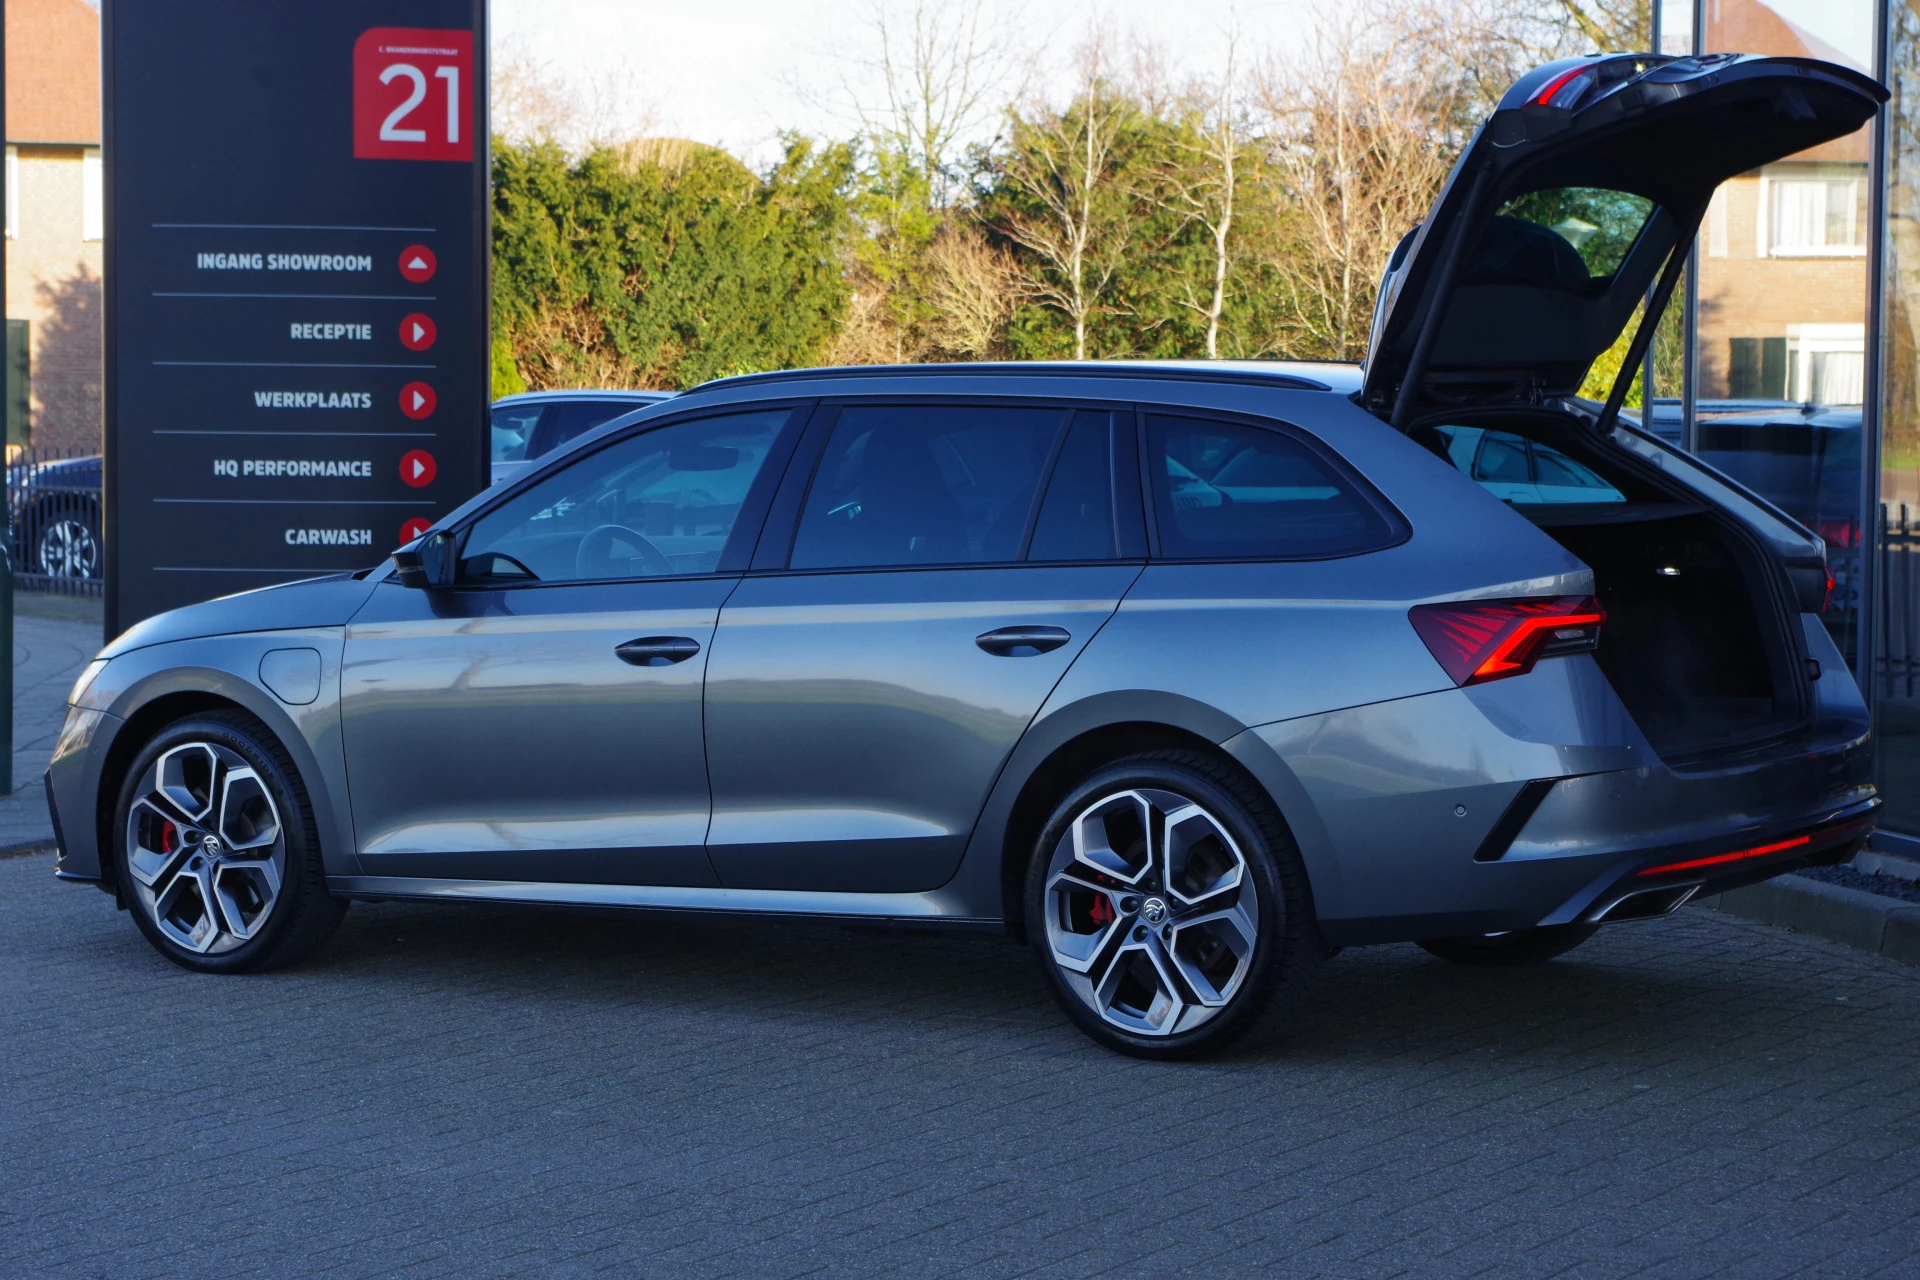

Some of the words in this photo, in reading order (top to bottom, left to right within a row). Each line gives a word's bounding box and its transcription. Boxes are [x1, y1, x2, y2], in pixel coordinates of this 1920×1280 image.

[379, 63, 459, 143] 21
[197, 253, 263, 269] INGANG
[267, 254, 371, 271] SHOWROOM
[291, 323, 371, 339] RECEPTIE
[254, 392, 371, 408] WERKPLAATS
[214, 460, 238, 477] HQ
[243, 460, 371, 476] PERFORMANCE
[285, 529, 371, 544] CARWASH
